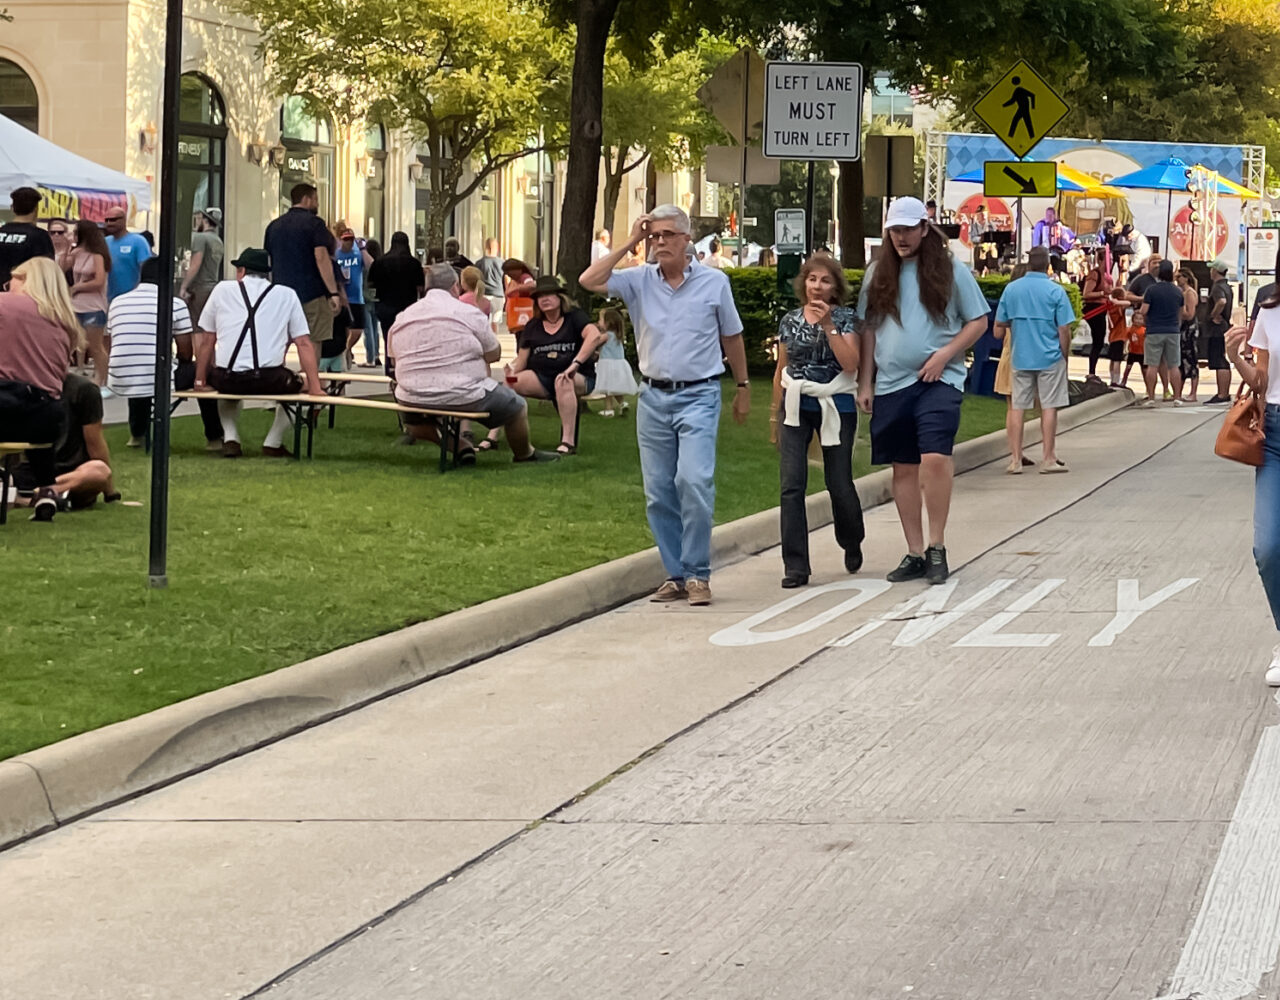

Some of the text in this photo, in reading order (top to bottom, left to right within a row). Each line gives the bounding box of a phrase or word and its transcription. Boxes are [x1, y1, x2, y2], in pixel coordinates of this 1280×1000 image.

[775, 75, 852, 91] LEFT LANE
[789, 102, 837, 120] MUST
[774, 131, 850, 147] TURN LEFT
[0, 232, 27, 244] TAFF
[709, 578, 1200, 647] ONLY
